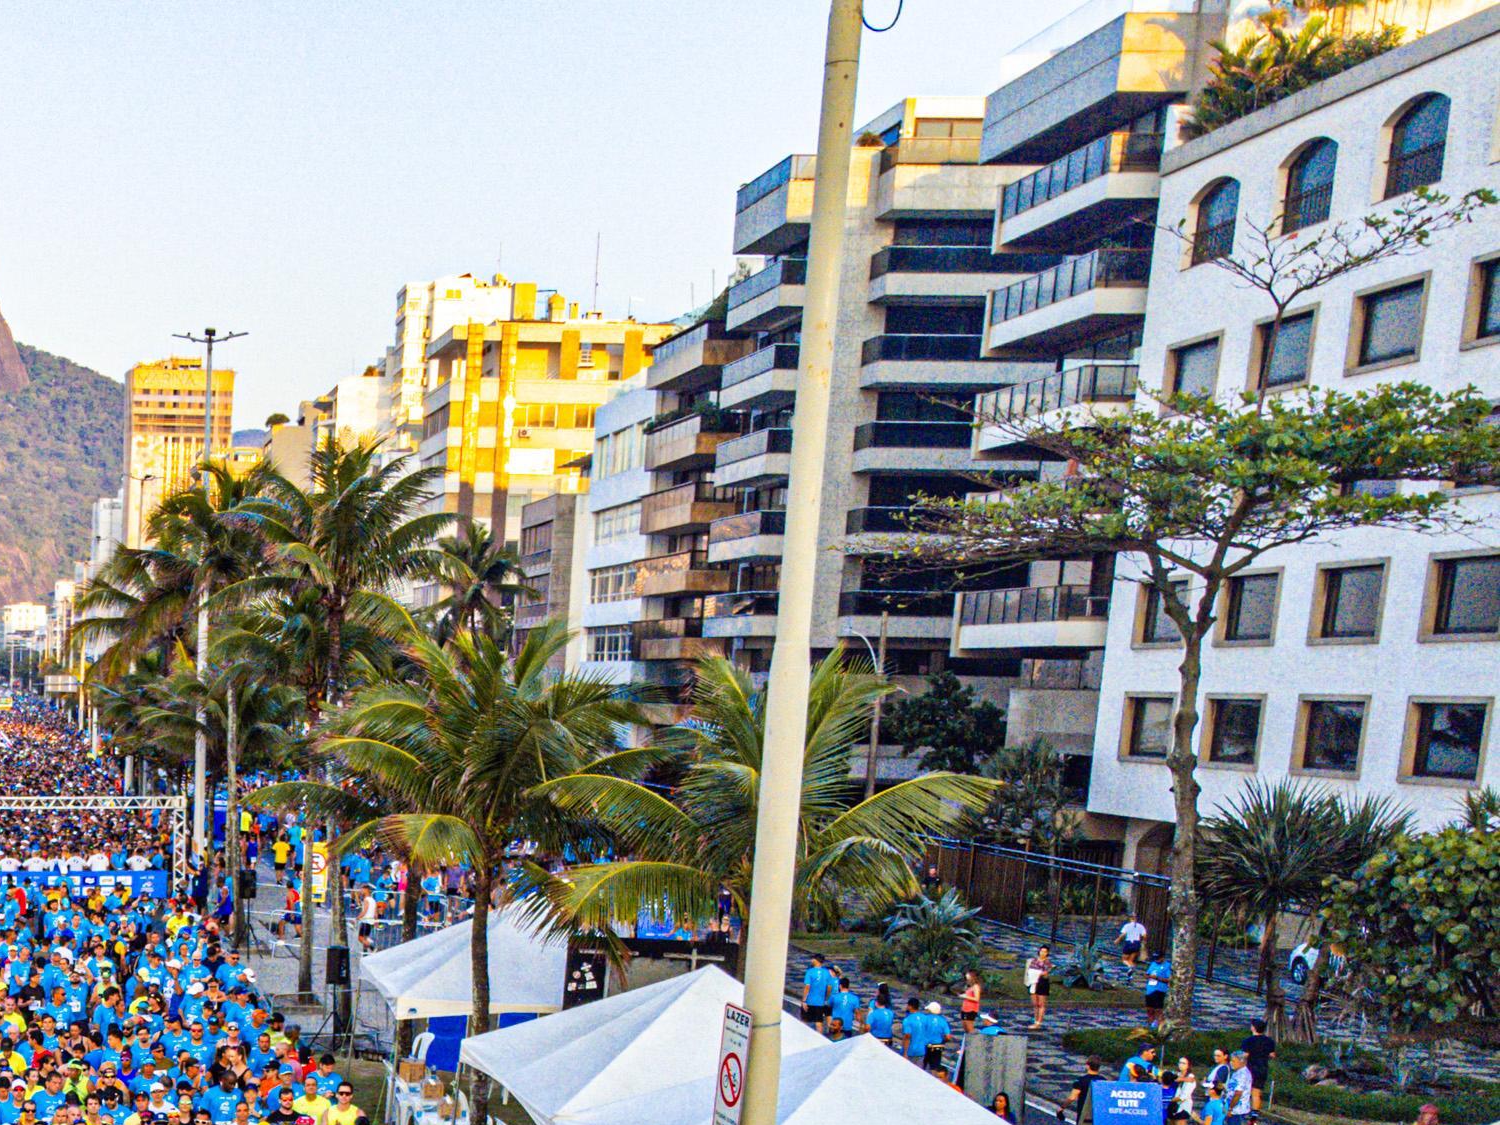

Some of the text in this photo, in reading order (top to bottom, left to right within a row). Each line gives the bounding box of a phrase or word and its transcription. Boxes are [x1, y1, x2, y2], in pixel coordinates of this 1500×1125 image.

[726, 1008, 750, 1028] LAZER
[1110, 1090, 1146, 1100] ACESSO
[1117, 1099, 1139, 1108] ELITE
